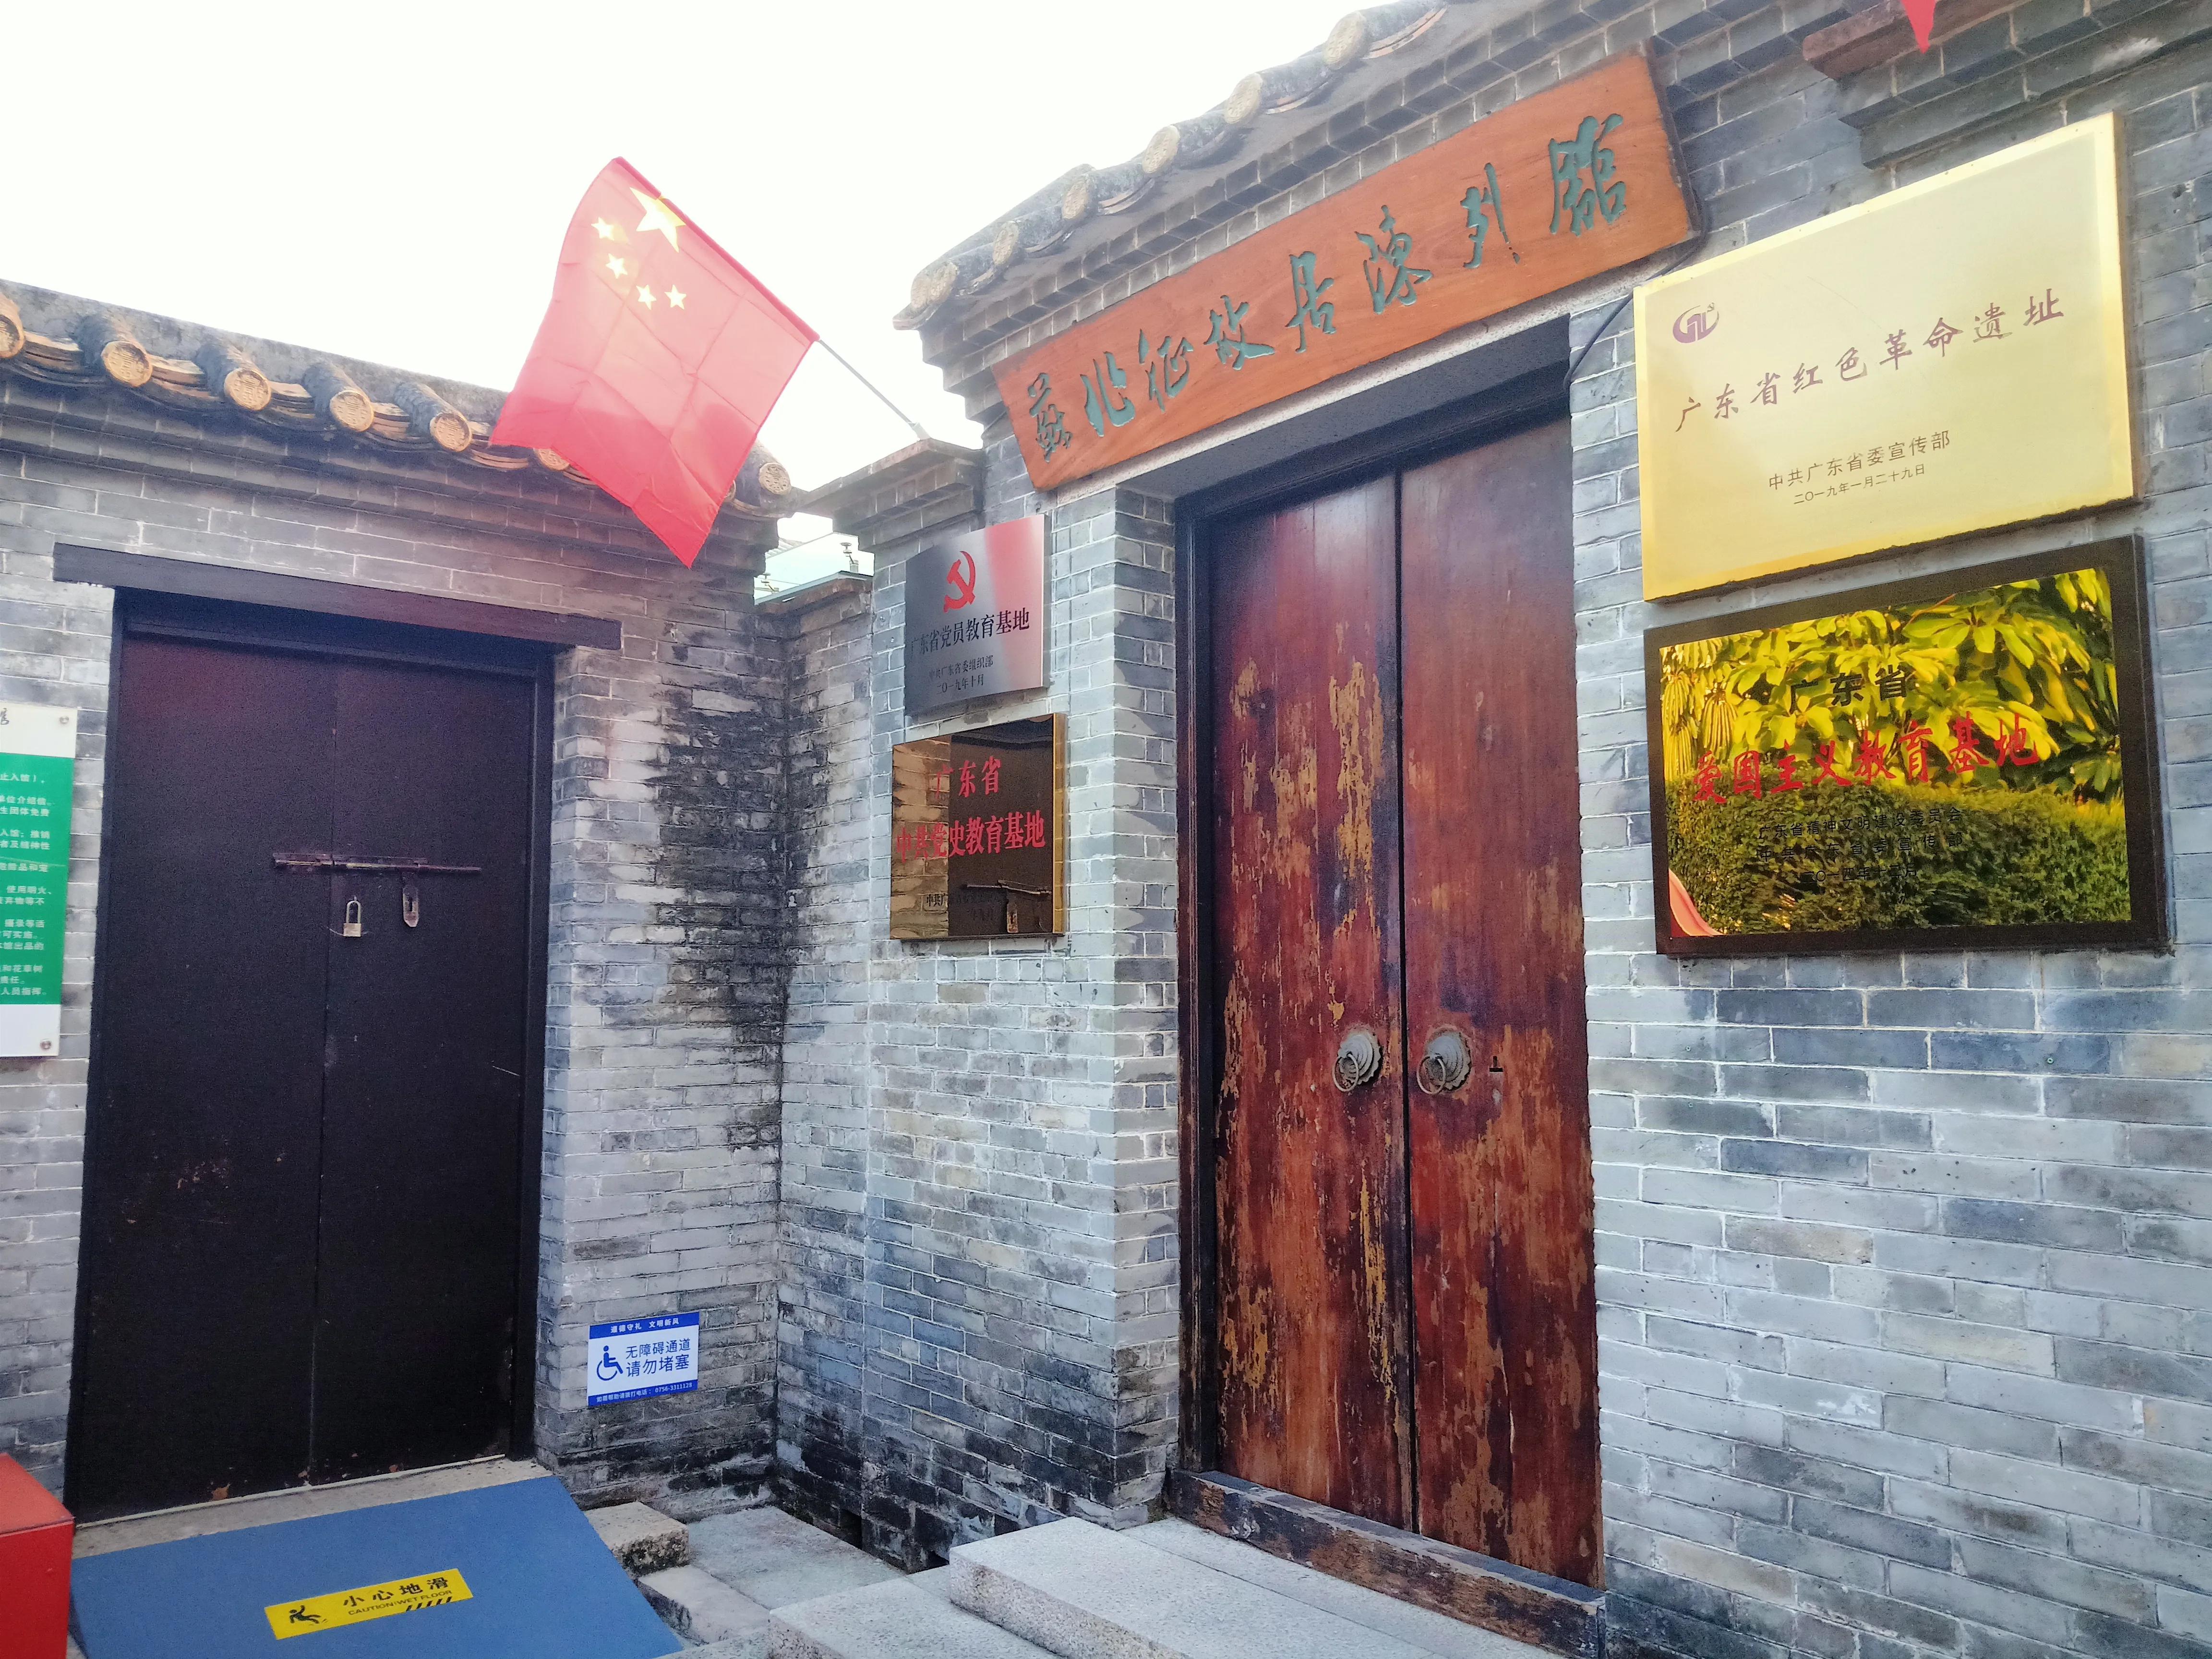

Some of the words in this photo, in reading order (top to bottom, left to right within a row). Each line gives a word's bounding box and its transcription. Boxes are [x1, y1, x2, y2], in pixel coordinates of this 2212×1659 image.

[1675, 288, 2065, 432] 广东省红色革命遗址
[1768, 430, 1951, 491] 中共广东省委宣传部
[911, 607, 1030, 655] 广东省党员教育基地
[929, 655, 994, 679] 中共广东省委组织部
[1790, 664, 1908, 715] 广东省
[1693, 711, 2040, 804] 爱国主义教育基地
[937, 756, 1002, 799] 广东省
[896, 809, 1046, 864] 中共党史教育基地
[1759, 807, 1961, 839] 广东省精神文明建设委员会
[1758, 832, 1963, 863] 中共广东省委宣传部
[649, 1318, 679, 1328] 文明新风
[625, 1338, 691, 1359] 无障碍通道
[625, 1354, 690, 1377] 请勿堵塞
[343, 1576, 448, 1607] 小心地滑
